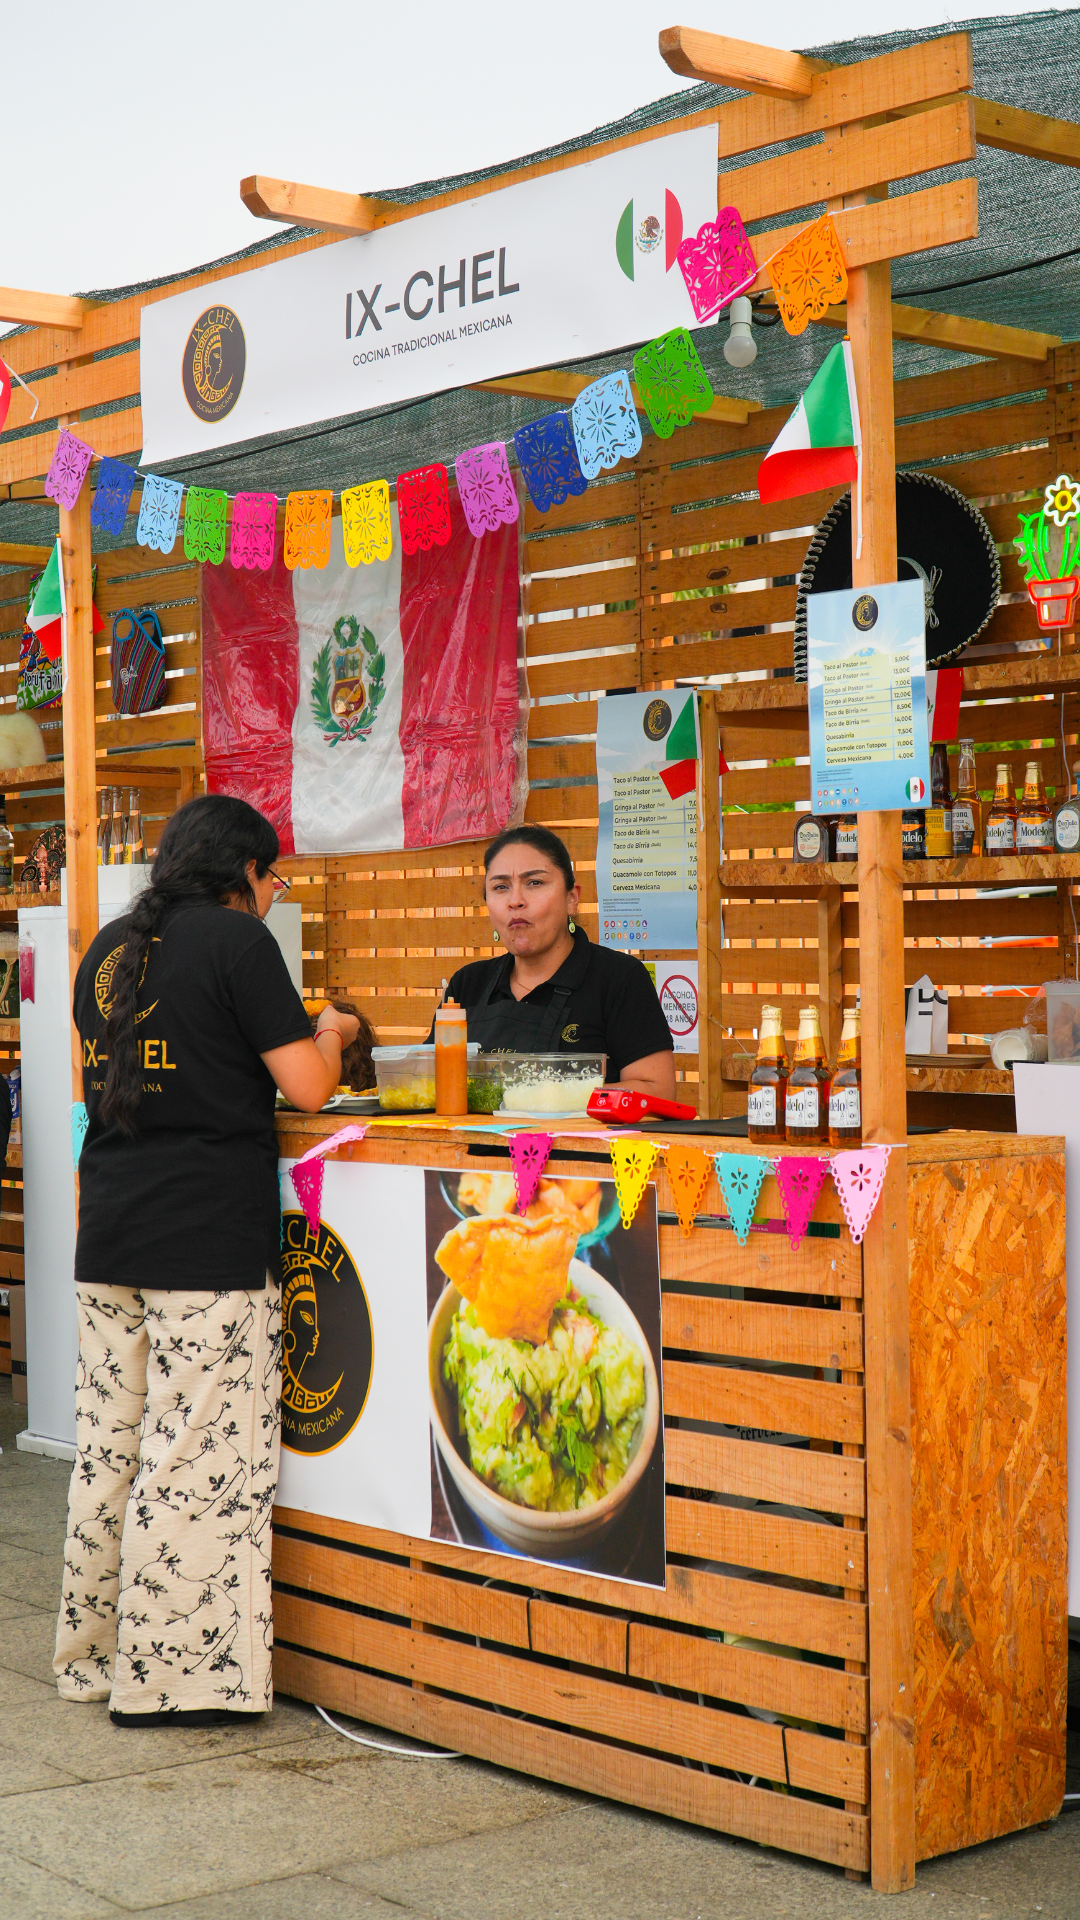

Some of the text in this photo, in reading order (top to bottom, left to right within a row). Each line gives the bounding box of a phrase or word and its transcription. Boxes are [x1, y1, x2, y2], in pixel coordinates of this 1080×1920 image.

[345, 246, 520, 340] IX-CHEL
[192, 308, 235, 343] IX-CHEL
[352, 313, 513, 366] COCINA TRADICIONAL MEXICANA
[196, 391, 234, 414] COCINA MEXICANA
[894, 655, 910, 663] 5,00€
[895, 679, 910, 687] 7,00€
[894, 715, 912, 723] 14,00€
[826, 732, 855, 741] Quesabirria
[826, 744, 855, 753] Guacamole
[866, 742, 887, 750] Totopos
[614, 817, 632, 825] Gringa
[1021, 826, 1049, 837] Modelo
[902, 832, 923, 842] odelo
[664, 991, 695, 999] ALCOHOL
[664, 1003, 695, 1011] MENORES
[298, 1407, 344, 1436] MEXICANA
